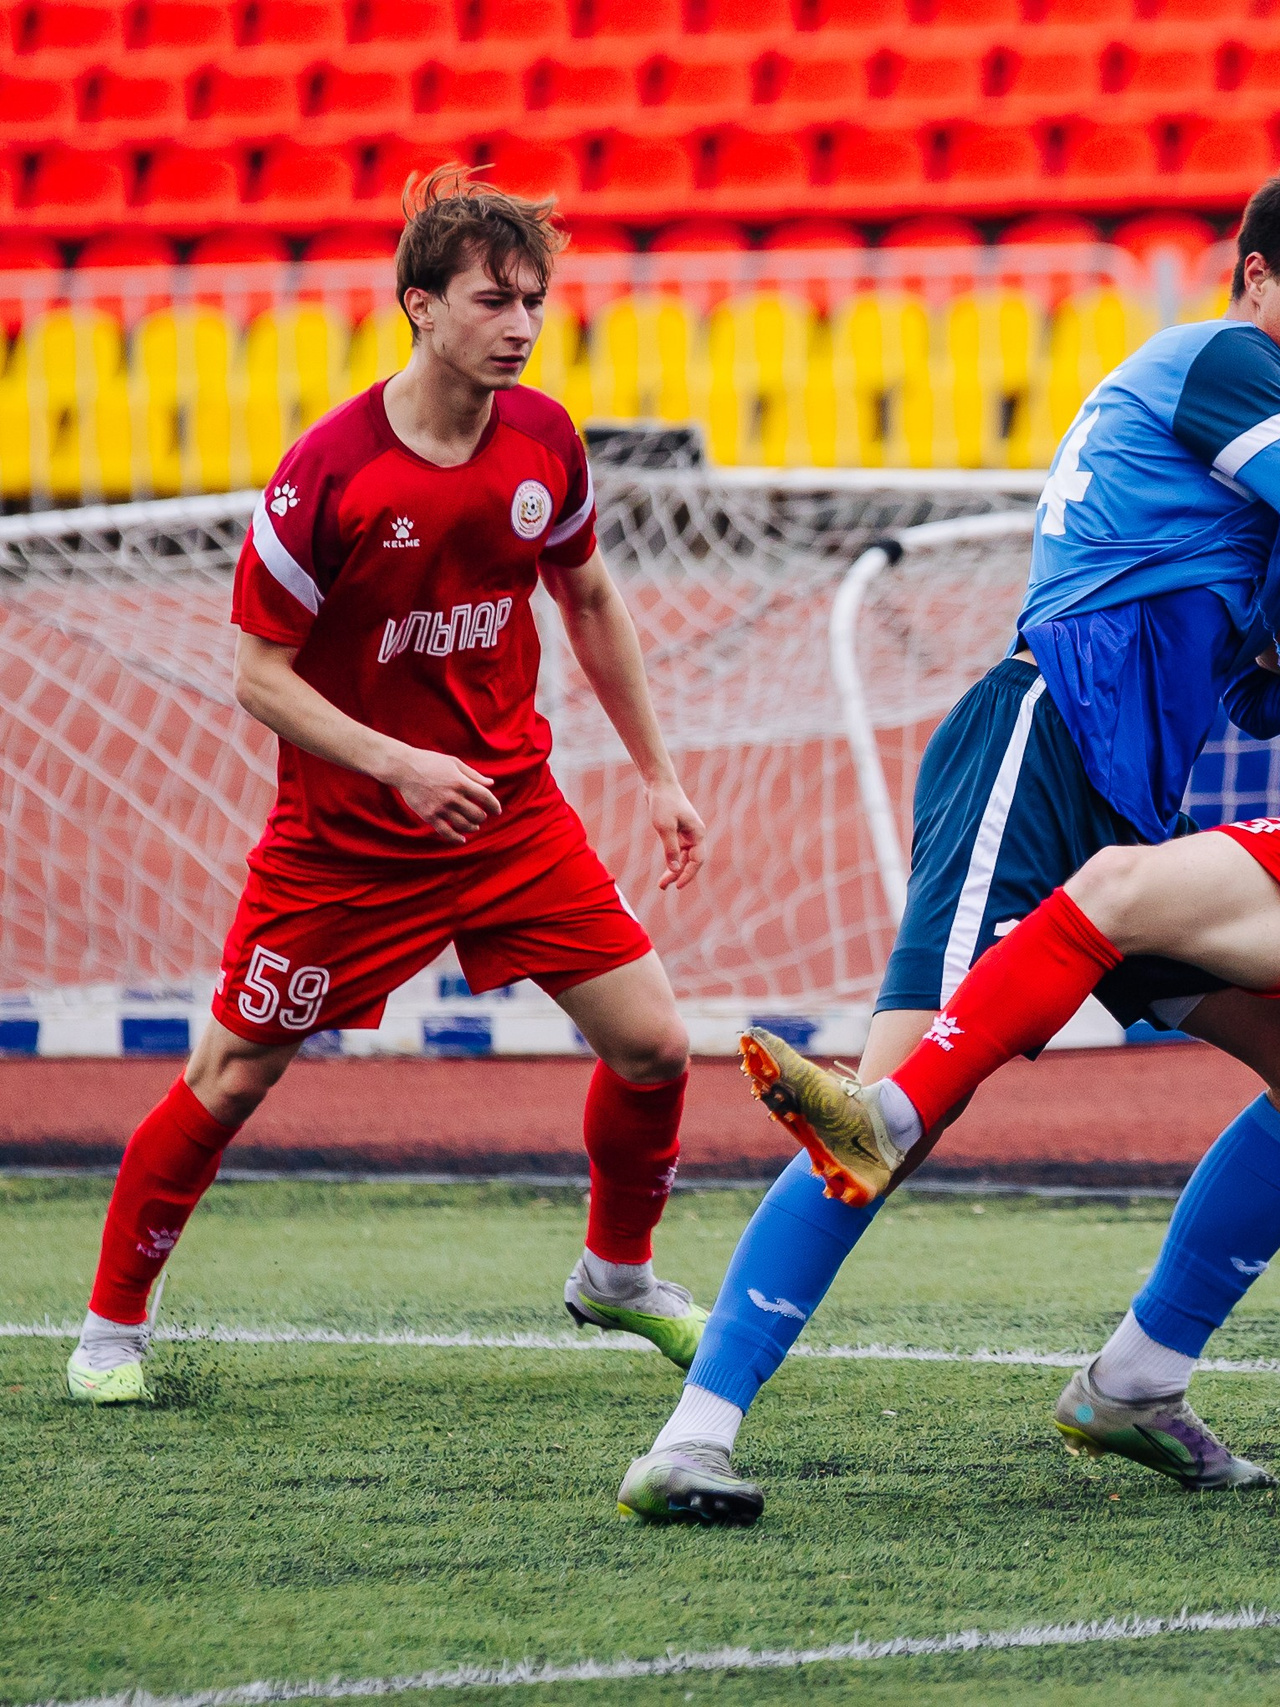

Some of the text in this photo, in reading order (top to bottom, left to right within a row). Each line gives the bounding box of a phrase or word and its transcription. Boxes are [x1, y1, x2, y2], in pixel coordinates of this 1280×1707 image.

[383, 539, 420, 548] KELME
[378, 597, 512, 663] ИЛЬПАР
[238, 944, 330, 1030] 59
